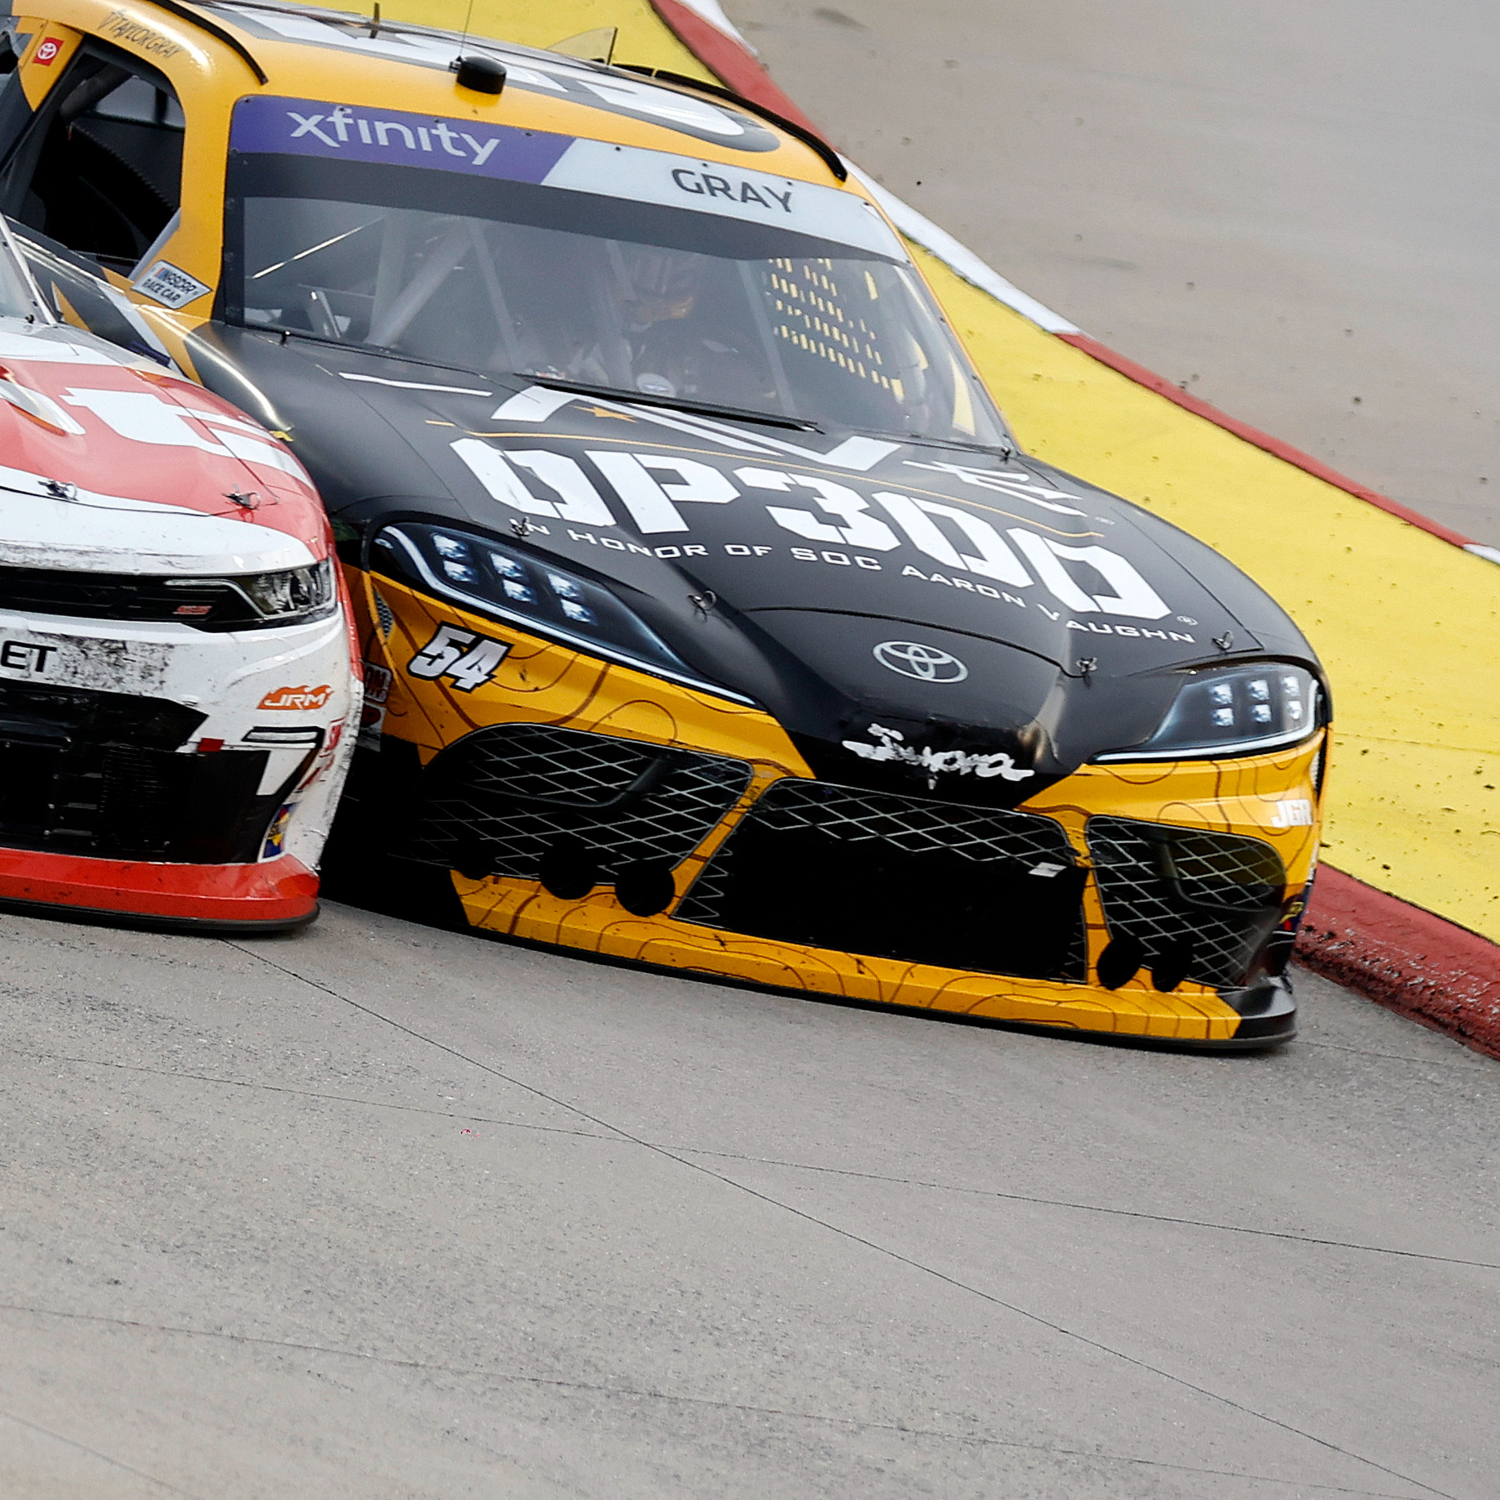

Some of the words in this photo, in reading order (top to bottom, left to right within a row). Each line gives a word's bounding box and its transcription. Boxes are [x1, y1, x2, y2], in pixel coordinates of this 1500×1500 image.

[288, 107, 501, 166] xfinity
[671, 167, 794, 214] GRAY
[567, 528, 708, 560] HONOR
[724, 543, 773, 558] OF
[790, 546, 884, 572] SOC
[901, 565, 1027, 609] AARON
[1037, 602, 1197, 645] VAUGHN
[408, 624, 512, 691] 54
[263, 692, 328, 711] JRM
[1270, 798, 1314, 829] JGR
